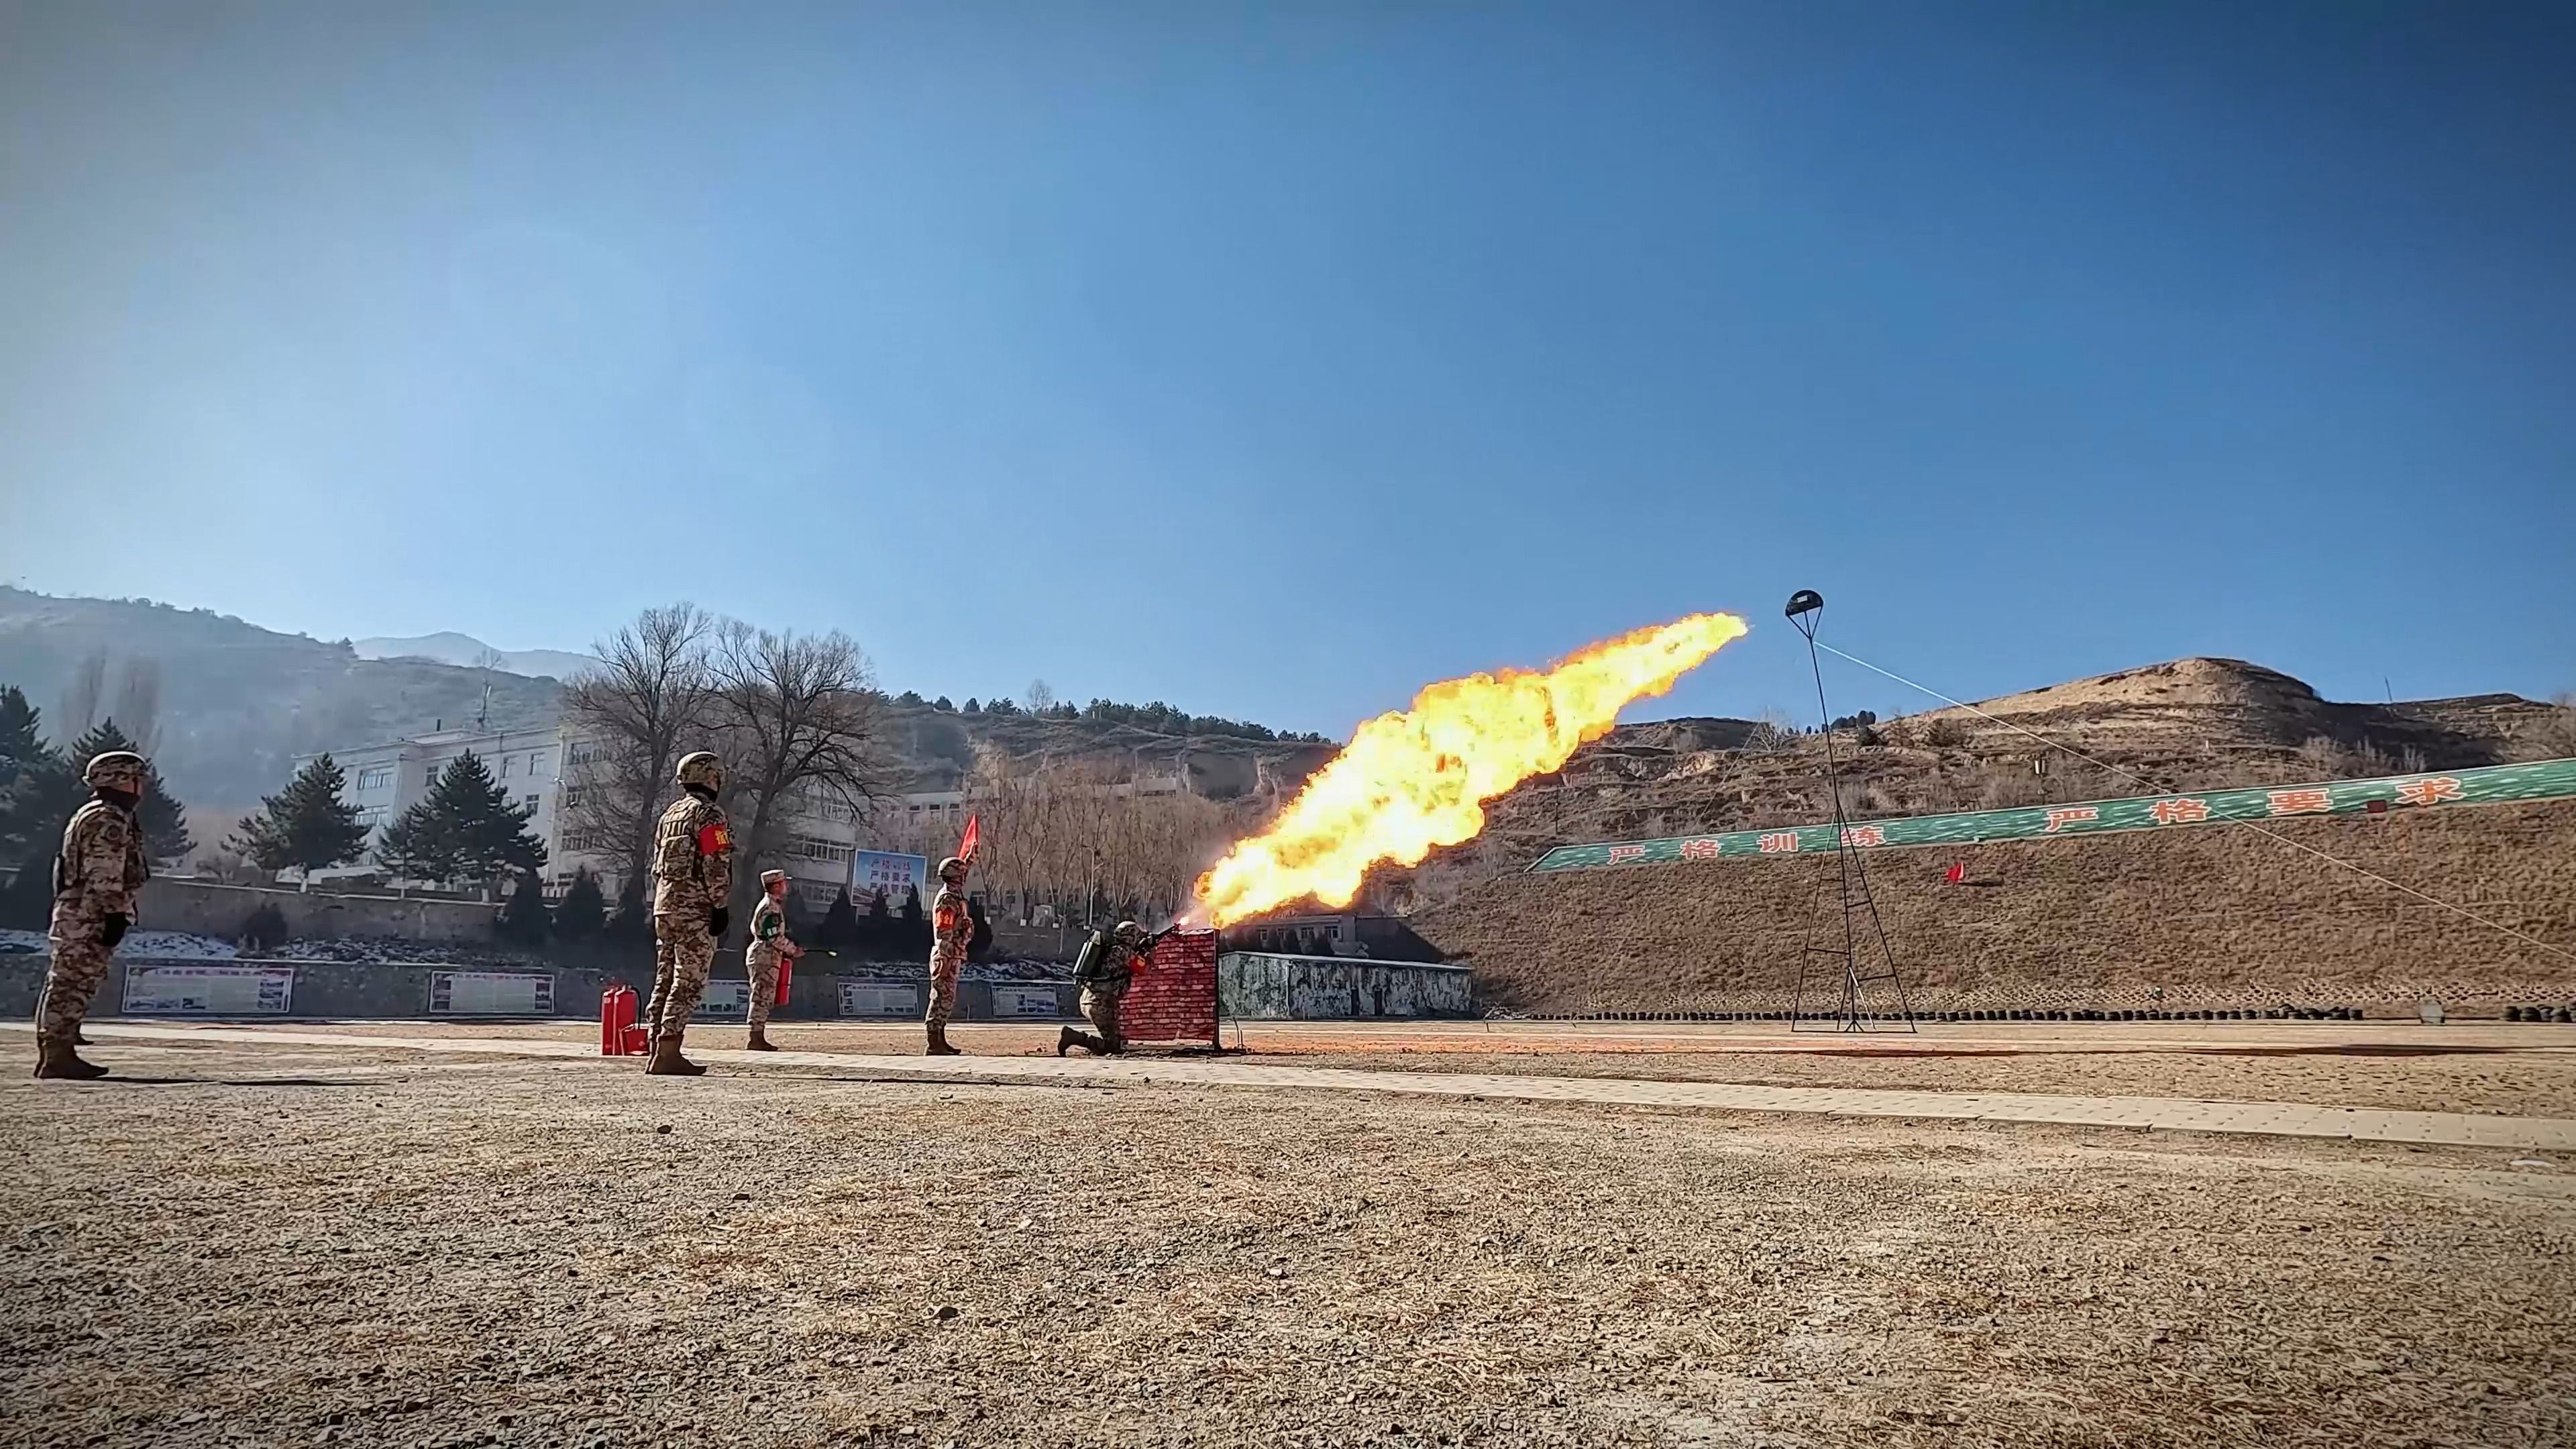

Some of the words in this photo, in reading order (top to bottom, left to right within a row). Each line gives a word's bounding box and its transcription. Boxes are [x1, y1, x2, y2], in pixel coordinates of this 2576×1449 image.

[1606, 826, 1886, 865] 严格训练
[2045, 776, 2467, 832] 严格要求
[870, 870, 911, 883] 严格要求
